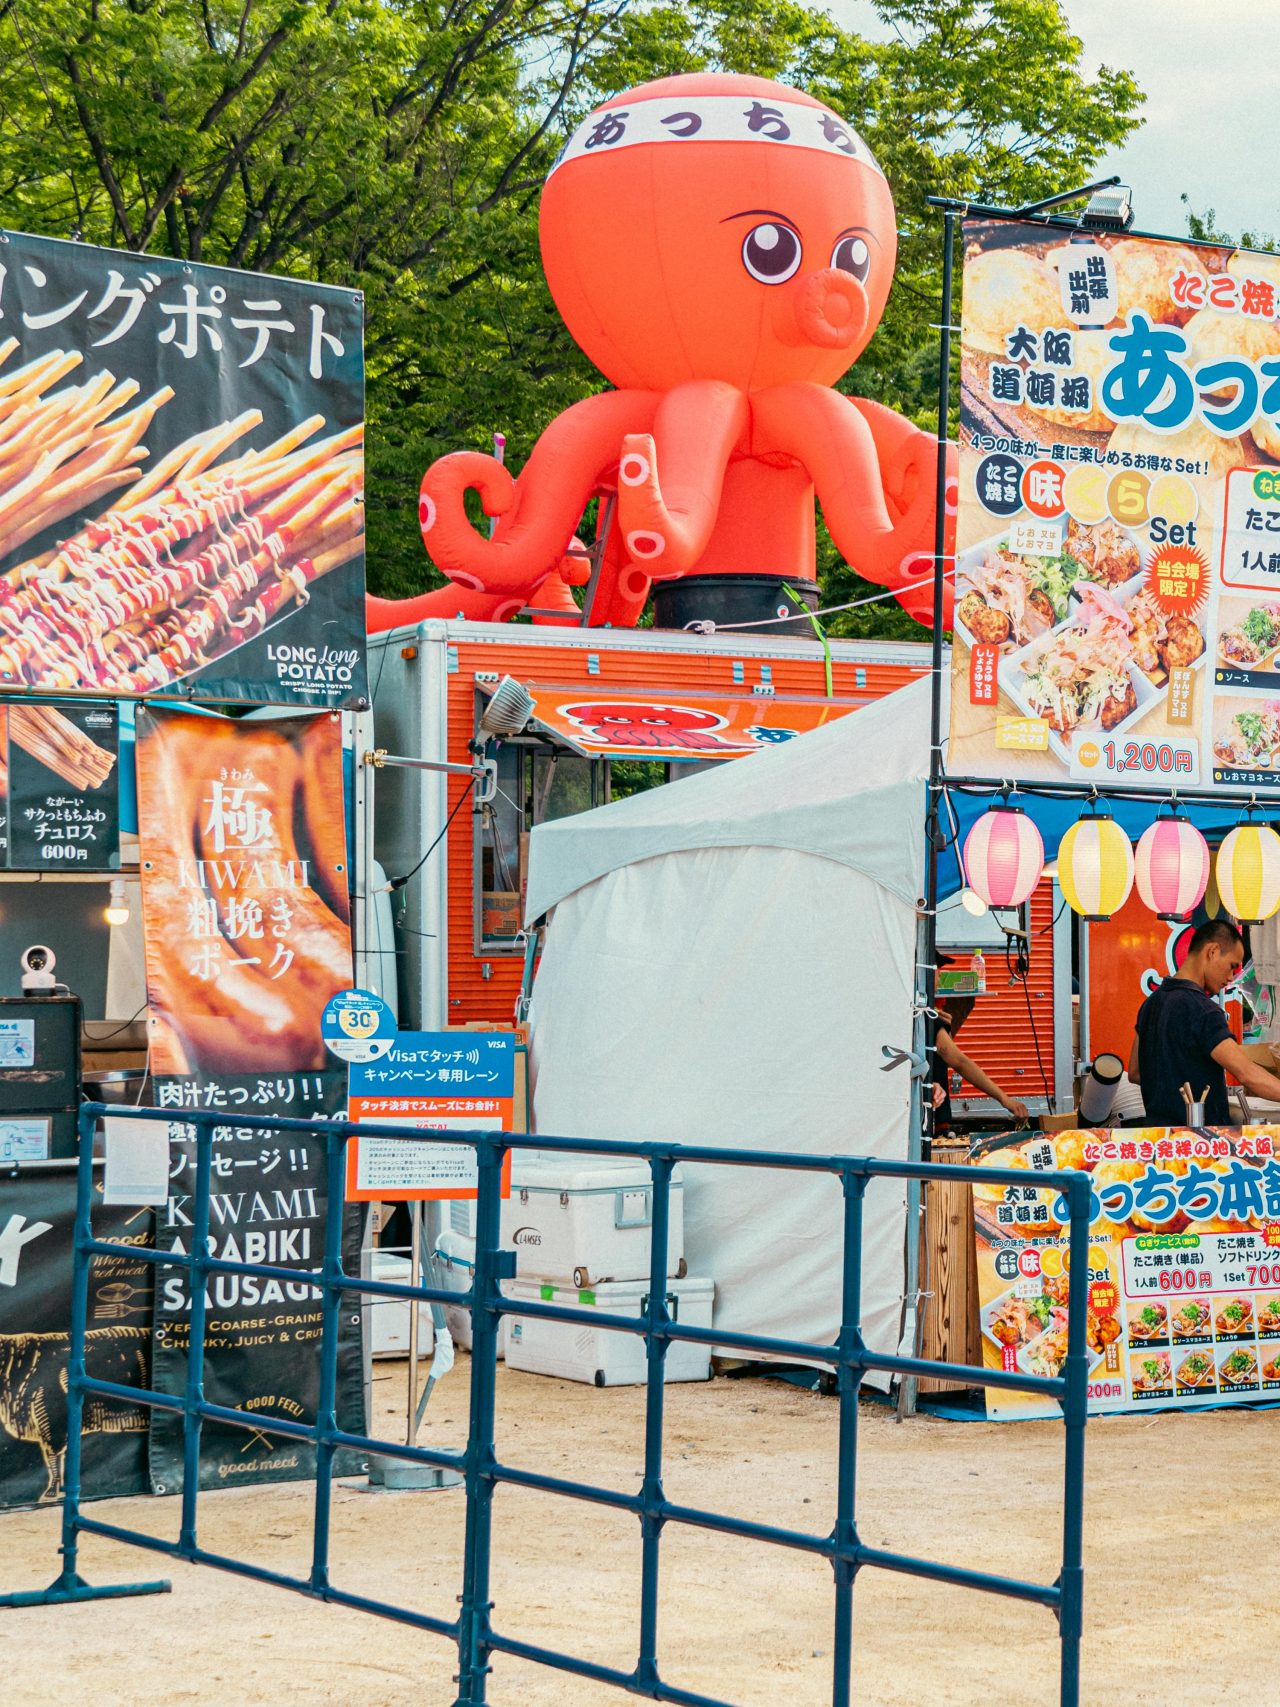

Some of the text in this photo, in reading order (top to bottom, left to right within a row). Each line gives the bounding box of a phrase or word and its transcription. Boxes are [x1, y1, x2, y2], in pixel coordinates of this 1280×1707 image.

[0, 263, 346, 380] ングポテト
[1009, 327, 1072, 366] 大阪
[992, 366, 1089, 409] 道頓堀
[1157, 561, 1201, 580] 当会場
[267, 644, 360, 668] LONG Long
[276, 662, 352, 682] POTATO
[1225, 672, 1250, 683] ソース
[1103, 741, 1193, 773] 1,200円
[219, 768, 255, 781] きわみ
[1223, 772, 1280, 784] しおマヨネーズ
[46, 797, 85, 807] ながーい
[24, 808, 107, 822] サクっともちふわ
[203, 781, 275, 853] 極
[34, 822, 97, 841] チュロス
[41, 845, 88, 860] 600円
[179, 860, 311, 889] KIWAMI
[187, 897, 293, 939] 粗挽き
[190, 943, 294, 981] ポーク
[487, 1040, 507, 1049] VISA
[364, 1069, 499, 1083] キャンペーン専用レーン
[1085, 1136, 1273, 1160] たこ焼き発祥の地 大阪
[165, 1188, 320, 1227] KWAMI
[1217, 1237, 1255, 1249] たこ焼き
[1135, 1269, 1212, 1290] 1人前 600円
[209, 1312, 324, 1332] COARSE-GRAINE
[246, 1395, 275, 1410] GOOD
[218, 1455, 299, 1478] good meat
